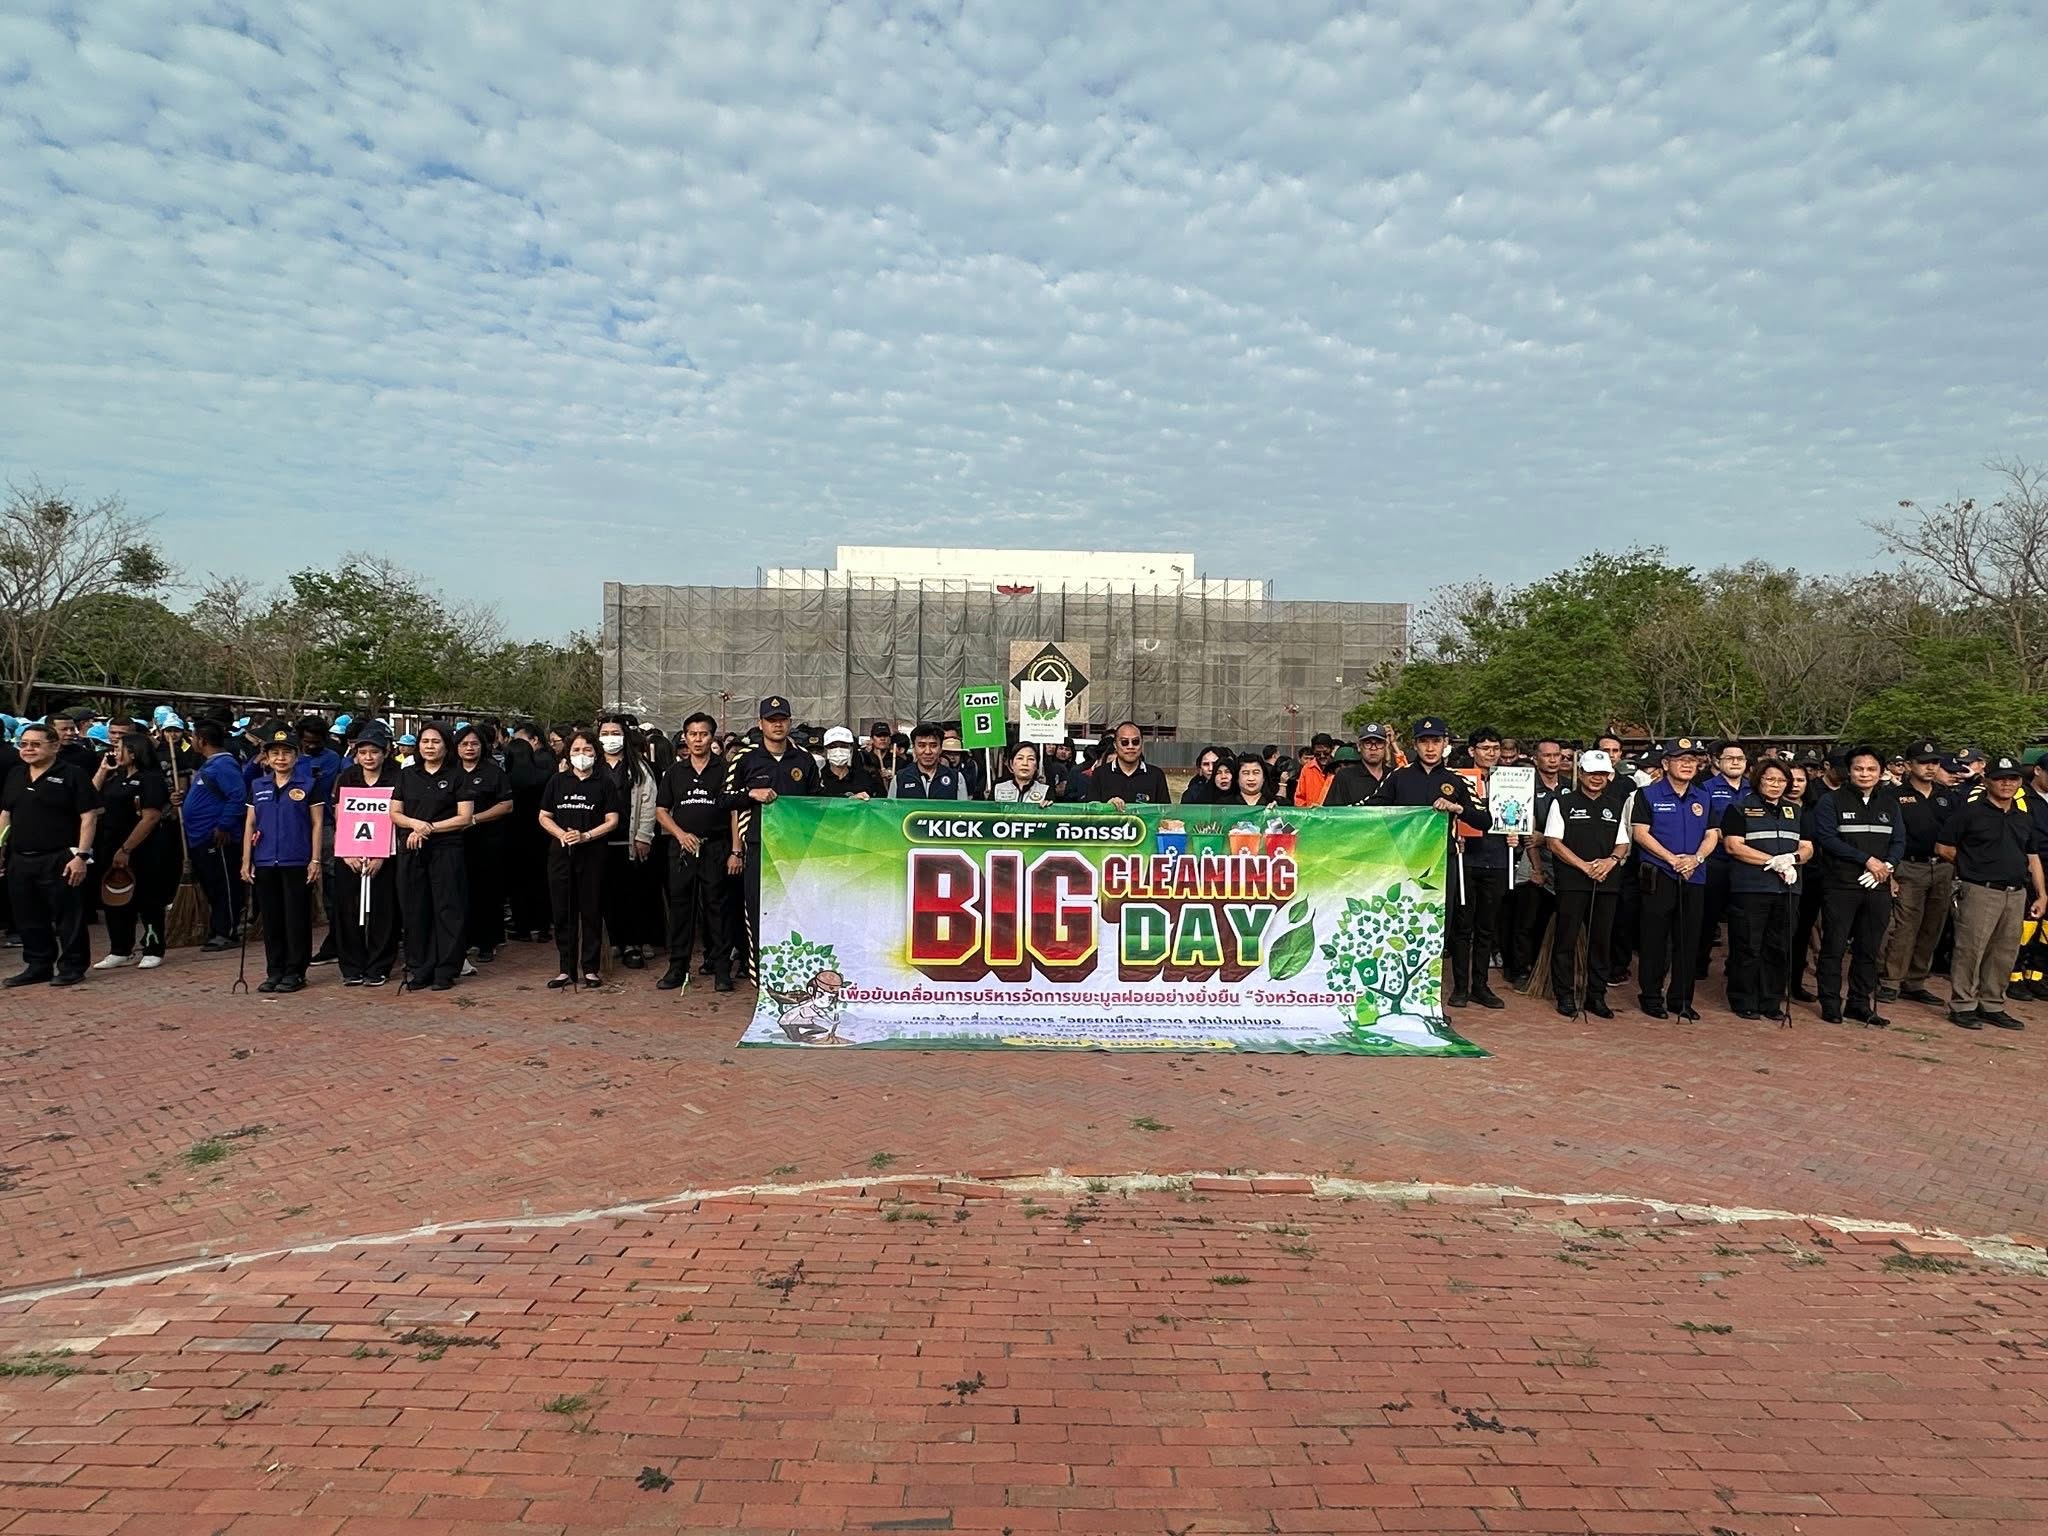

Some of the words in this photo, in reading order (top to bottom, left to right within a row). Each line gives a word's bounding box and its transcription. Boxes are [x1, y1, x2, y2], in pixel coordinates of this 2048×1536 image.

[965, 694, 999, 706] Zone
[976, 715, 990, 731] B
[346, 798, 388, 812] Zone
[355, 823, 372, 840] A
[1056, 823, 1138, 841] กิจกรรม
[908, 850, 1098, 965] BIG
[1102, 854, 1297, 900] CLEANING
[1120, 903, 1276, 966] DAY
